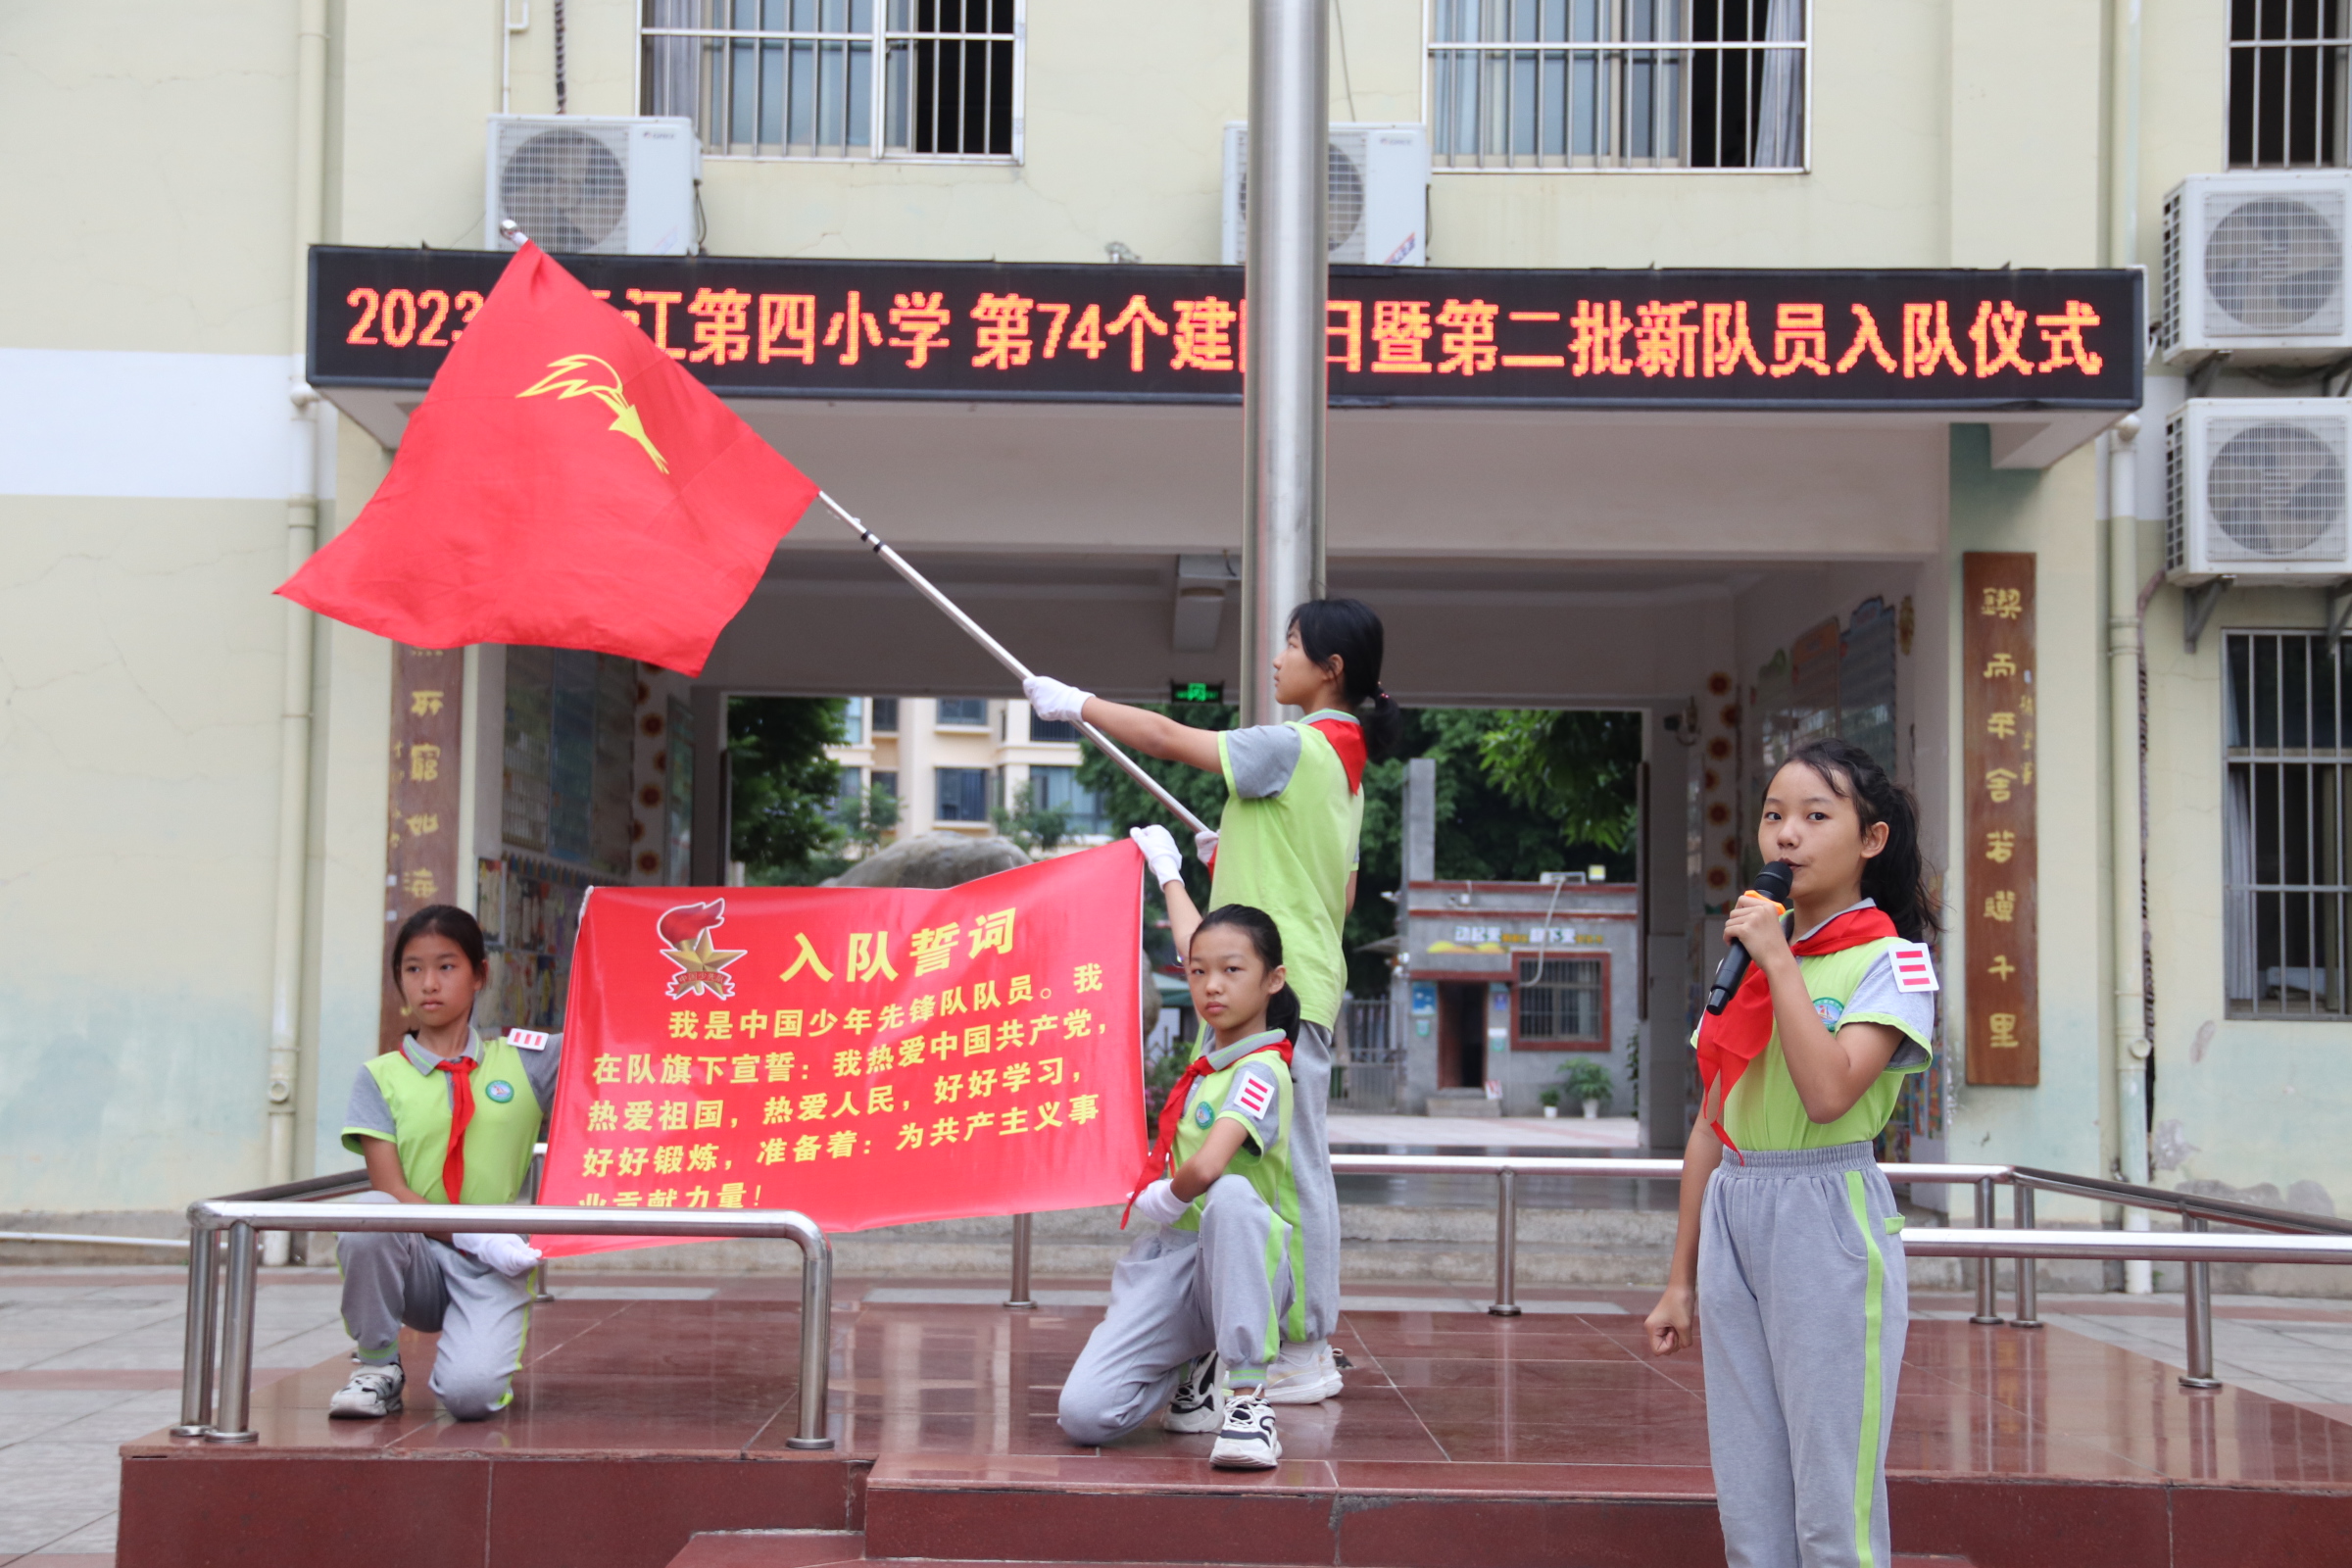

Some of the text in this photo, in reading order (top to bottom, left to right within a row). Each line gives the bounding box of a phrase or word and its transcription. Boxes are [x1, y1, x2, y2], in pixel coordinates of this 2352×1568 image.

[970, 292, 2103, 378] 第74个建日暨第二批新队员入队仪式
[777, 907, 1016, 983] 入队誓词
[668, 962, 1103, 1040] 我是中国少年先锋队队员。我
[592, 1008, 1106, 1085] 在队旗下宣誓：我热爱中国共产党，
[587, 1056, 1082, 1132] 热爱祖国，热爱人民，好好学习，
[582, 1093, 1100, 1178] 好好锻炼，准备着：为共产主义事
